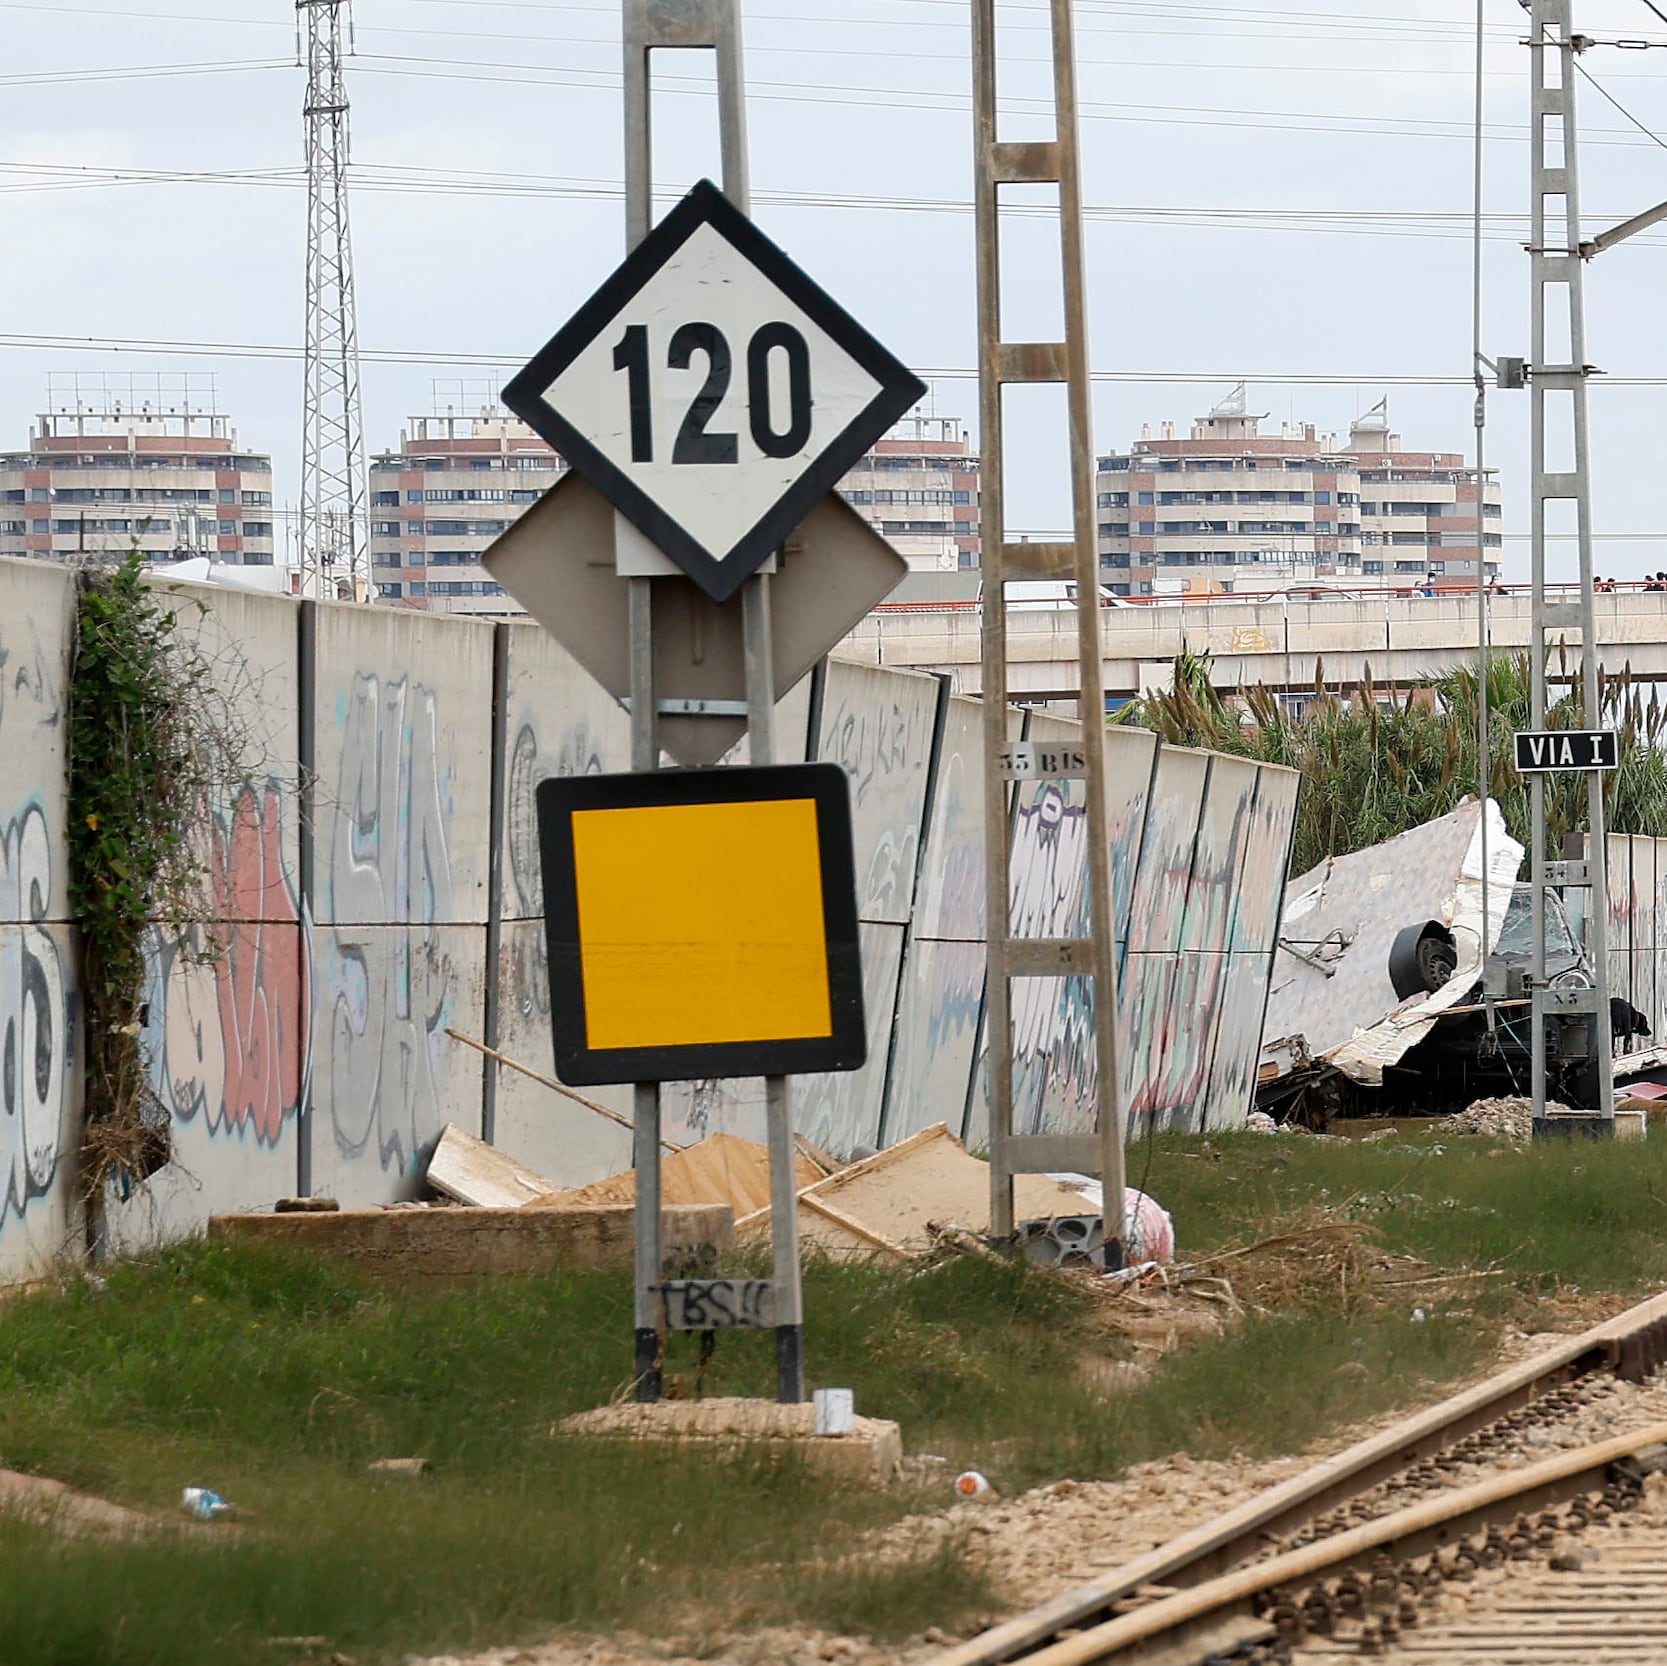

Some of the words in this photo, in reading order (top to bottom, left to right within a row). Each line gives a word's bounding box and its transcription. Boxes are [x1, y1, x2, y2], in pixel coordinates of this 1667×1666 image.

[612, 320, 813, 465] 120
[1528, 736, 1574, 766] VIA
[1589, 735, 1604, 764] I
